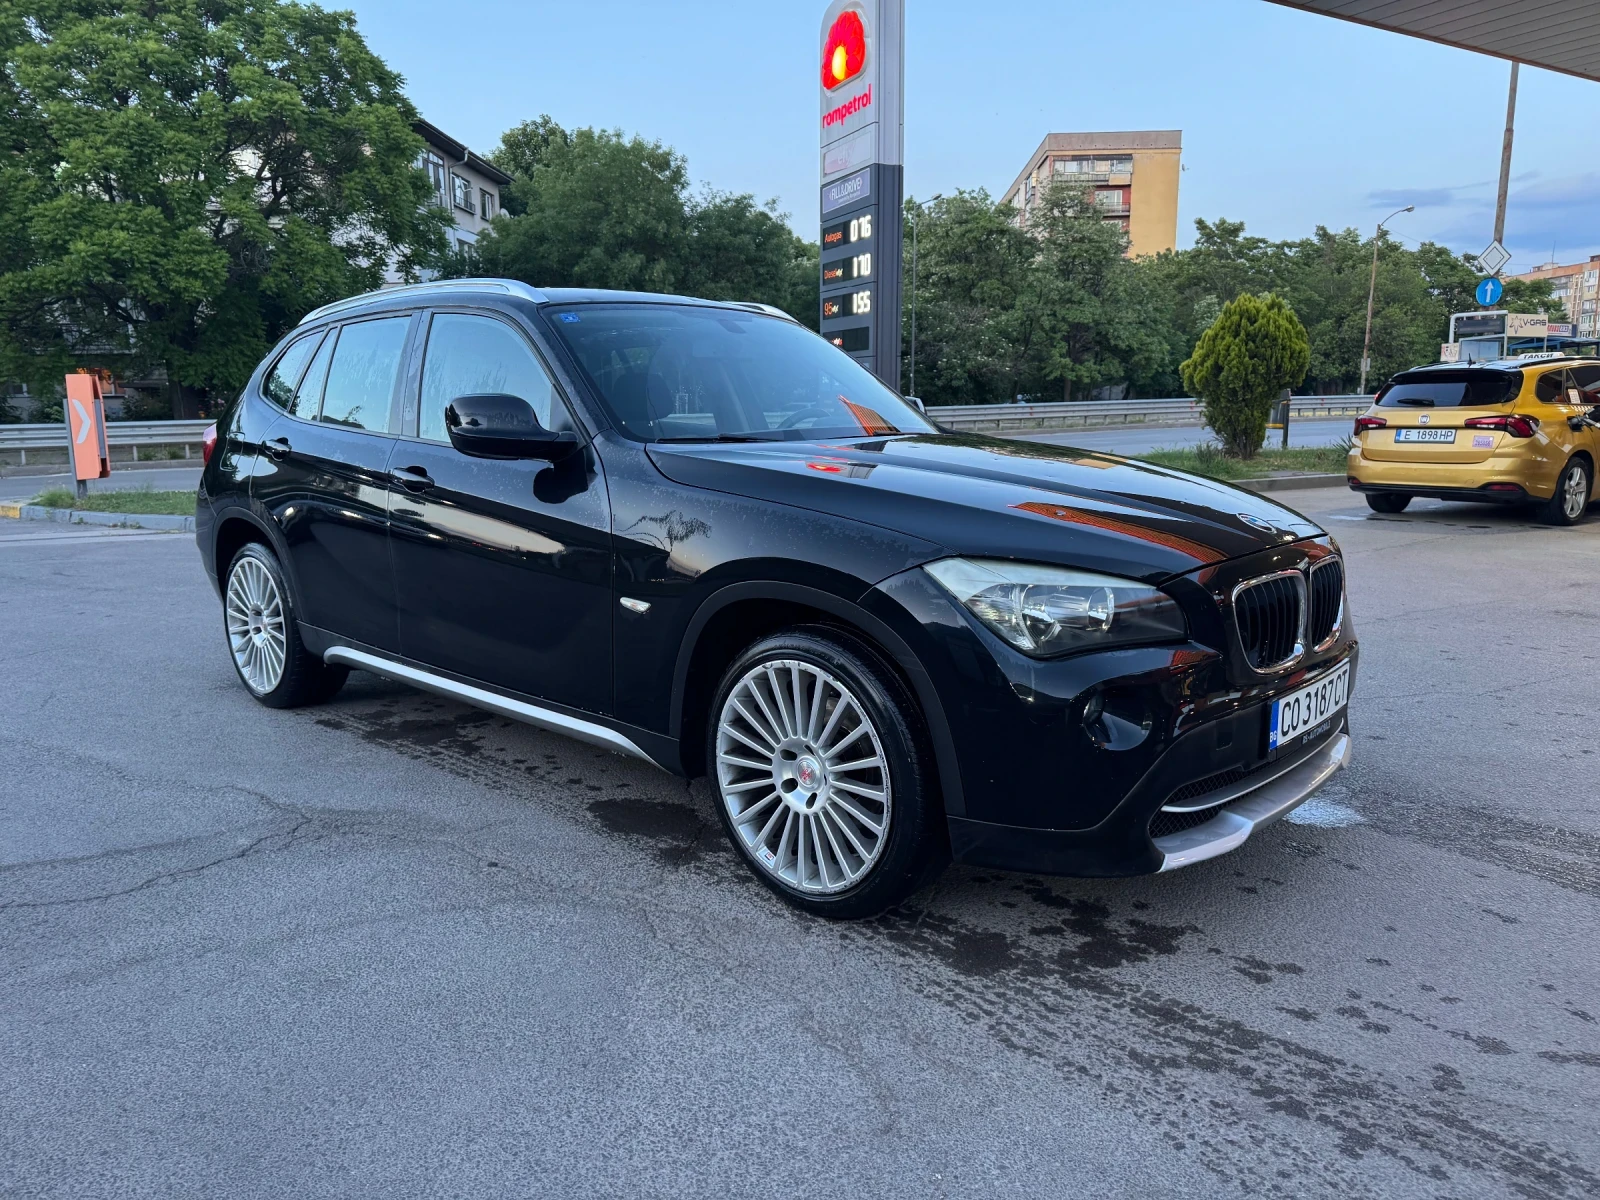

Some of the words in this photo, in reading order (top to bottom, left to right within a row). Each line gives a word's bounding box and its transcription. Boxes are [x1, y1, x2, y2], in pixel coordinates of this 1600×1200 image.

[822, 83, 872, 129] rompetrol
[825, 231, 843, 243] Autogas
[852, 253, 871, 278] 170
[824, 302, 833, 316] 95
[852, 290, 871, 314] 155
[1404, 430, 1411, 440] E
[1416, 430, 1438, 440] 1898
[1439, 430, 1454, 440] HP
[1269, 730, 1278, 742] BG
